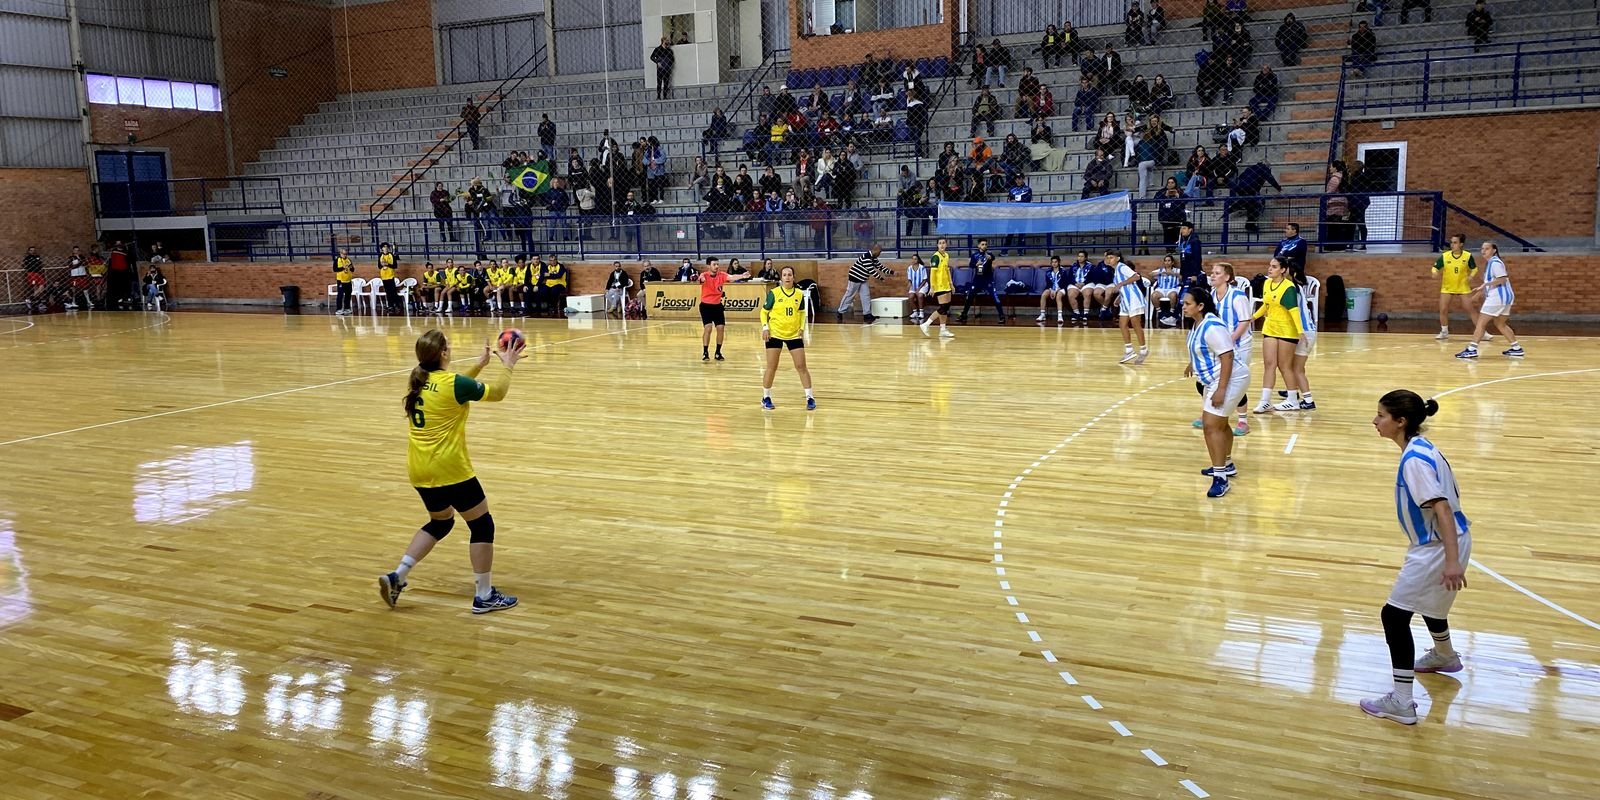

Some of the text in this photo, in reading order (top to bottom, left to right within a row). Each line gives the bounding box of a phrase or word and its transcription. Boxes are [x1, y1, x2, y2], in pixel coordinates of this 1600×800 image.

[653, 291, 697, 308] Pisossul
[786, 307, 793, 316] 18
[412, 396, 425, 428] 6
